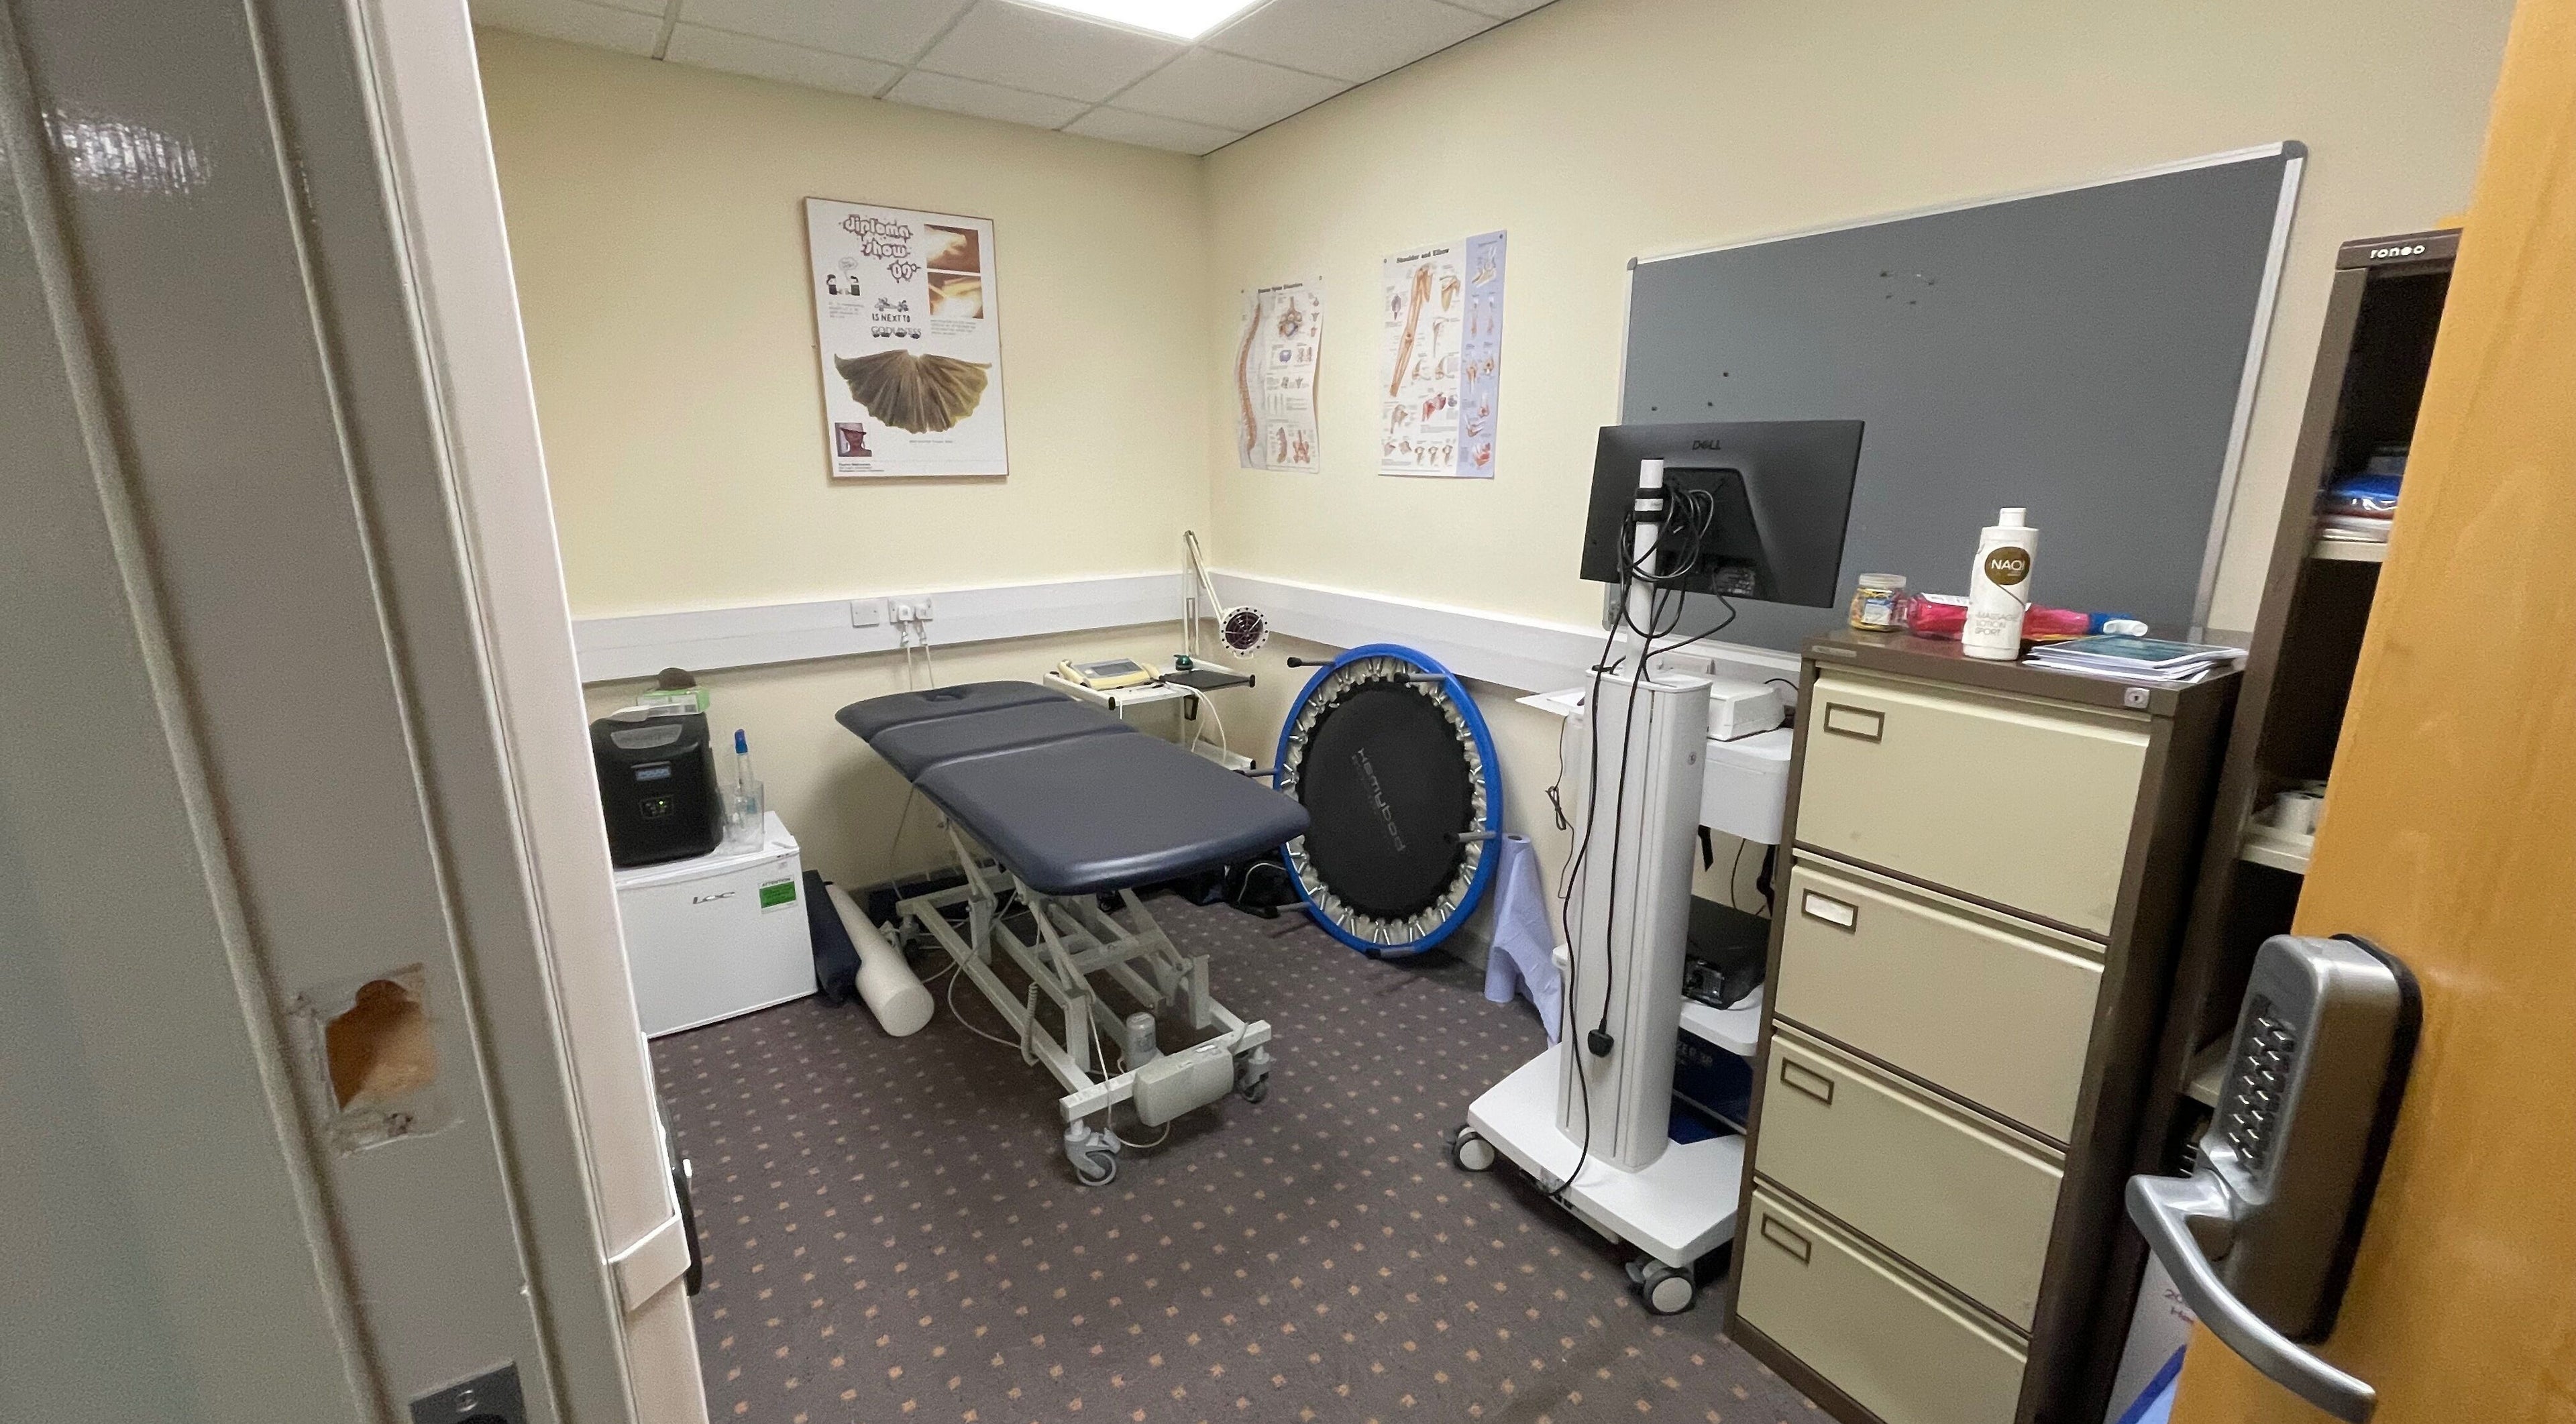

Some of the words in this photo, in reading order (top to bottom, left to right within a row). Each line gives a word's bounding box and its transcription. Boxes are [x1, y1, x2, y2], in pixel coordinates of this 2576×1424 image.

[871, 313, 879, 321] IS
[881, 314, 901, 323] NEXT
[903, 315, 911, 323] TO
[1692, 439, 1721, 451] DELL
[1974, 626, 2001, 635] SPORT
